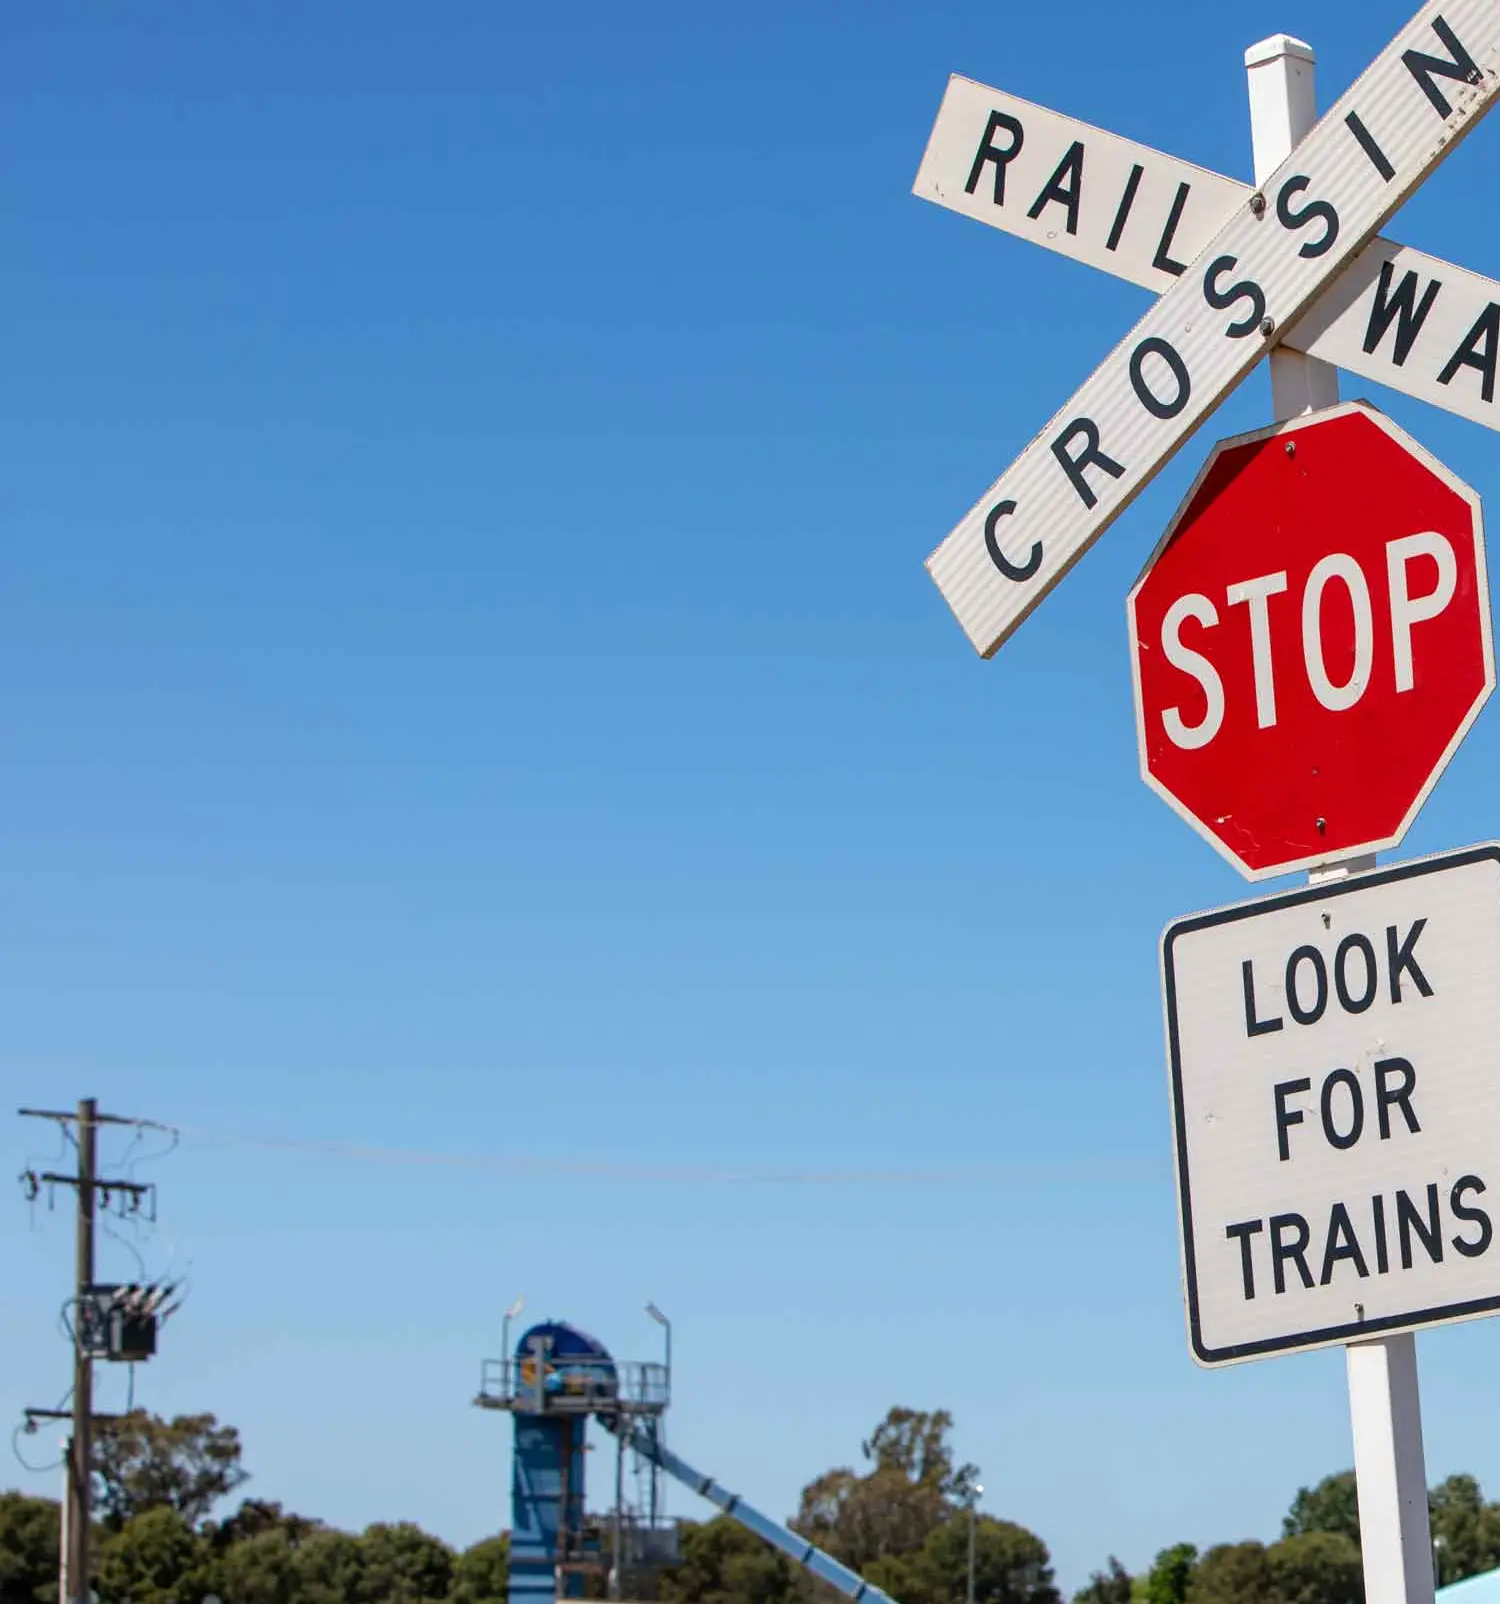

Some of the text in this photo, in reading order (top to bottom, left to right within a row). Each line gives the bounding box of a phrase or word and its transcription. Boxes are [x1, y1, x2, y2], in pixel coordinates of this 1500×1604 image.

[1161, 531, 1457, 750] STOP
[1241, 918, 1434, 1037] LOOK
[1273, 1057, 1421, 1162] FOR
[1226, 1175, 1493, 1300] TRAINS
